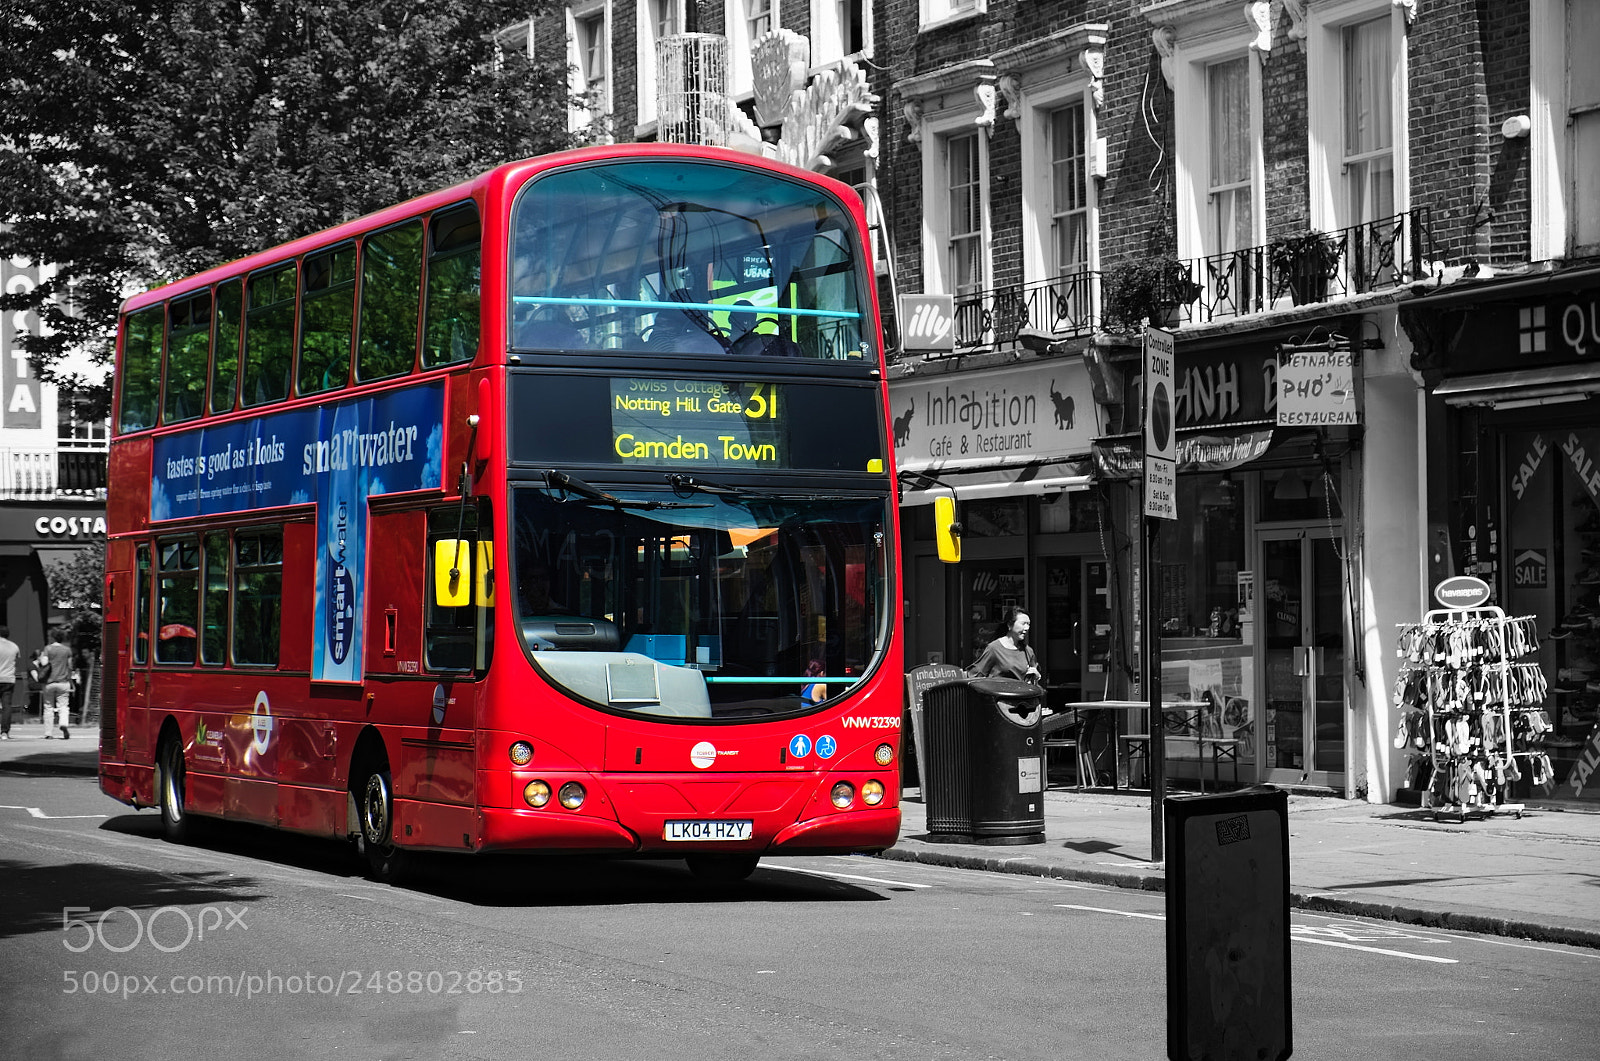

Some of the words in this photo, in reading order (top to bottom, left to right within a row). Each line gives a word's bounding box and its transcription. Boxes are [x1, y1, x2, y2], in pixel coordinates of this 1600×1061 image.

[909, 303, 952, 345] illy
[1148, 335, 1173, 356] Controlled
[1152, 355, 1170, 378] ZONE
[1280, 355, 1360, 368] ETNAMESE
[629, 379, 667, 392] Swiss
[673, 379, 730, 398] Cottage
[744, 383, 777, 418] 31
[615, 395, 670, 416] Notting
[676, 397, 701, 412] Hill
[707, 398, 742, 413] Gate
[926, 386, 1036, 430] Inhabition
[1279, 411, 1361, 424] RESTAURANT
[303, 420, 418, 476] smartwater
[614, 433, 709, 460] Camden
[718, 436, 776, 461] Town
[929, 436, 952, 457] Café
[960, 434, 969, 455] &
[976, 430, 1032, 454] Restaurant
[1232, 434, 1254, 460] Food
[167, 454, 194, 480] tastes
[208, 443, 232, 480] good
[232, 448, 246, 469] as
[256, 435, 286, 466] looks
[1511, 433, 1547, 500] SALE
[1562, 432, 1600, 497] SALE
[35, 517, 105, 534] COSTA
[335, 501, 347, 660] smartwater
[973, 572, 998, 596] illy
[1515, 566, 1546, 585] SALE
[841, 716, 901, 729] VNW32390
[672, 823, 710, 838] LK04
[716, 823, 745, 838] HZY
